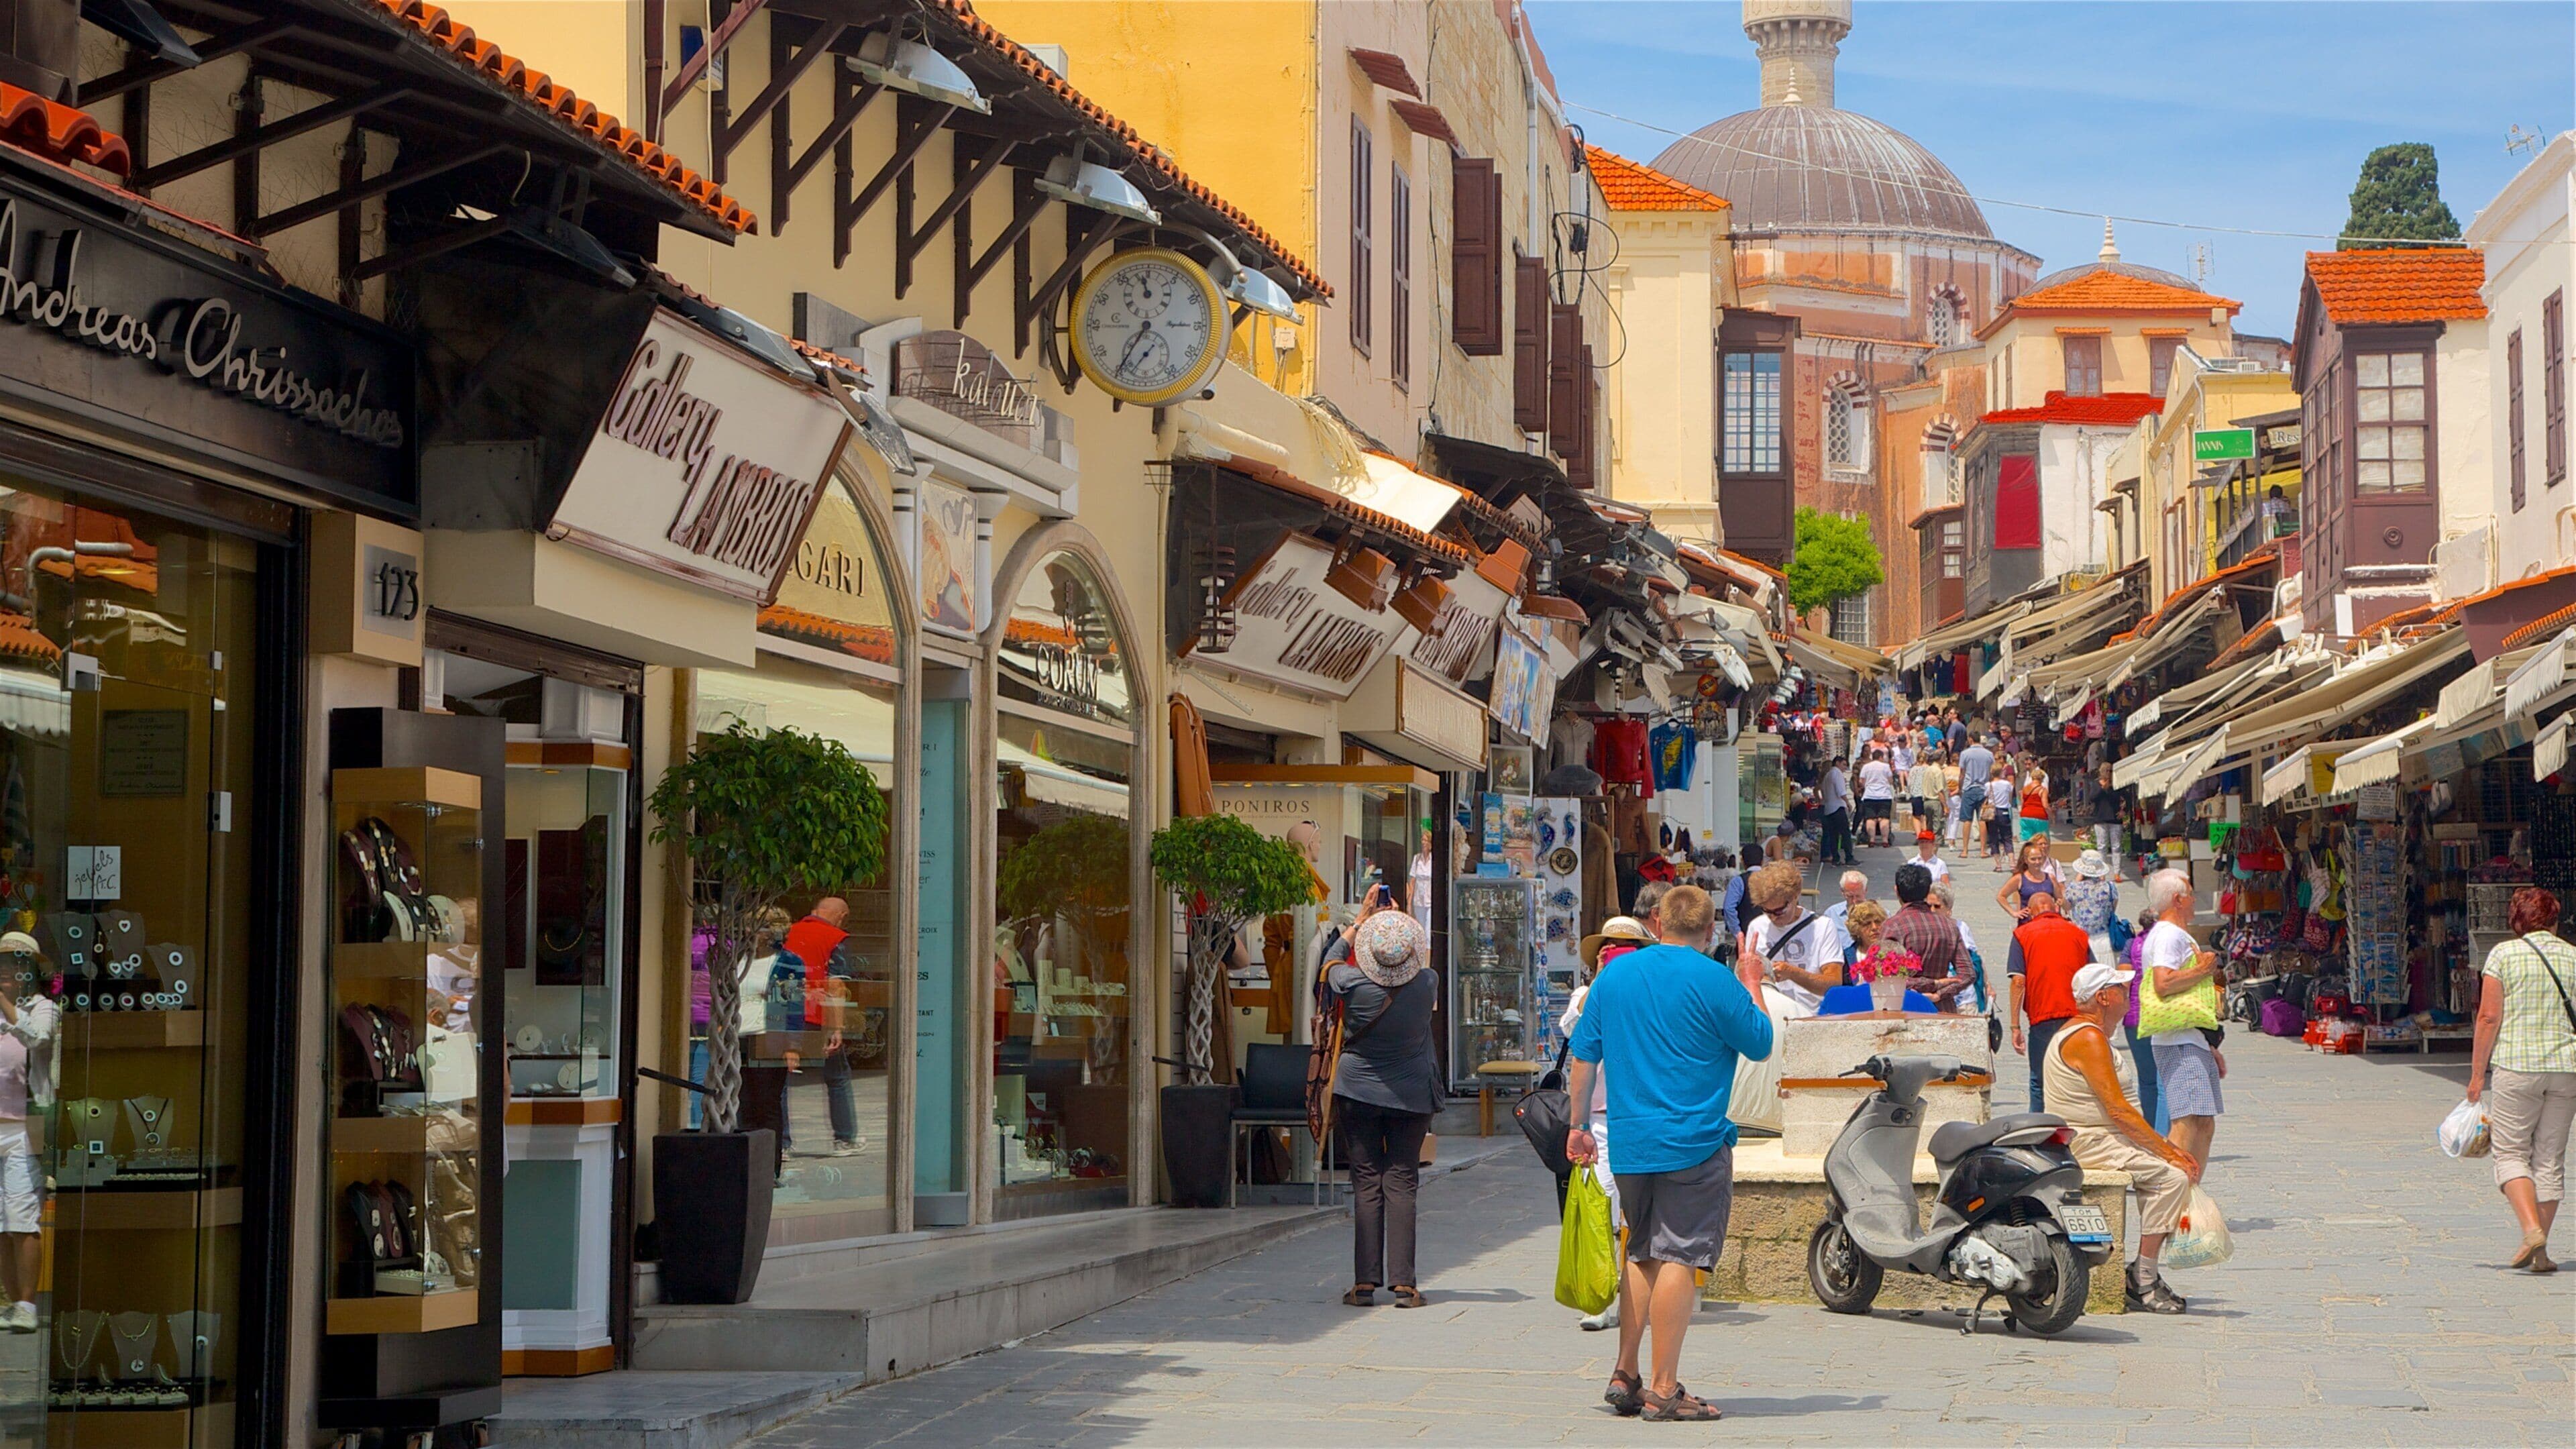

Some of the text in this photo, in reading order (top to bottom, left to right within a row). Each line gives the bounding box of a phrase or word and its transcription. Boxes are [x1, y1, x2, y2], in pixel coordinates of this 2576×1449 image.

[0, 199, 157, 360] Andreas
[1092, 319, 1101, 331] 45
[1193, 320, 1203, 331] 15
[606, 339, 723, 484] Gallery
[668, 444, 813, 580] LAMBROS
[379, 562, 419, 621] 123
[788, 539, 867, 598] GARI
[1234, 559, 1319, 633] Gallery
[1036, 642, 1100, 701] CORUM
[1277, 608, 1387, 684] LAMBROS
[1221, 800, 1310, 814] PONIROS
[2068, 1218, 2105, 1232] 6610
